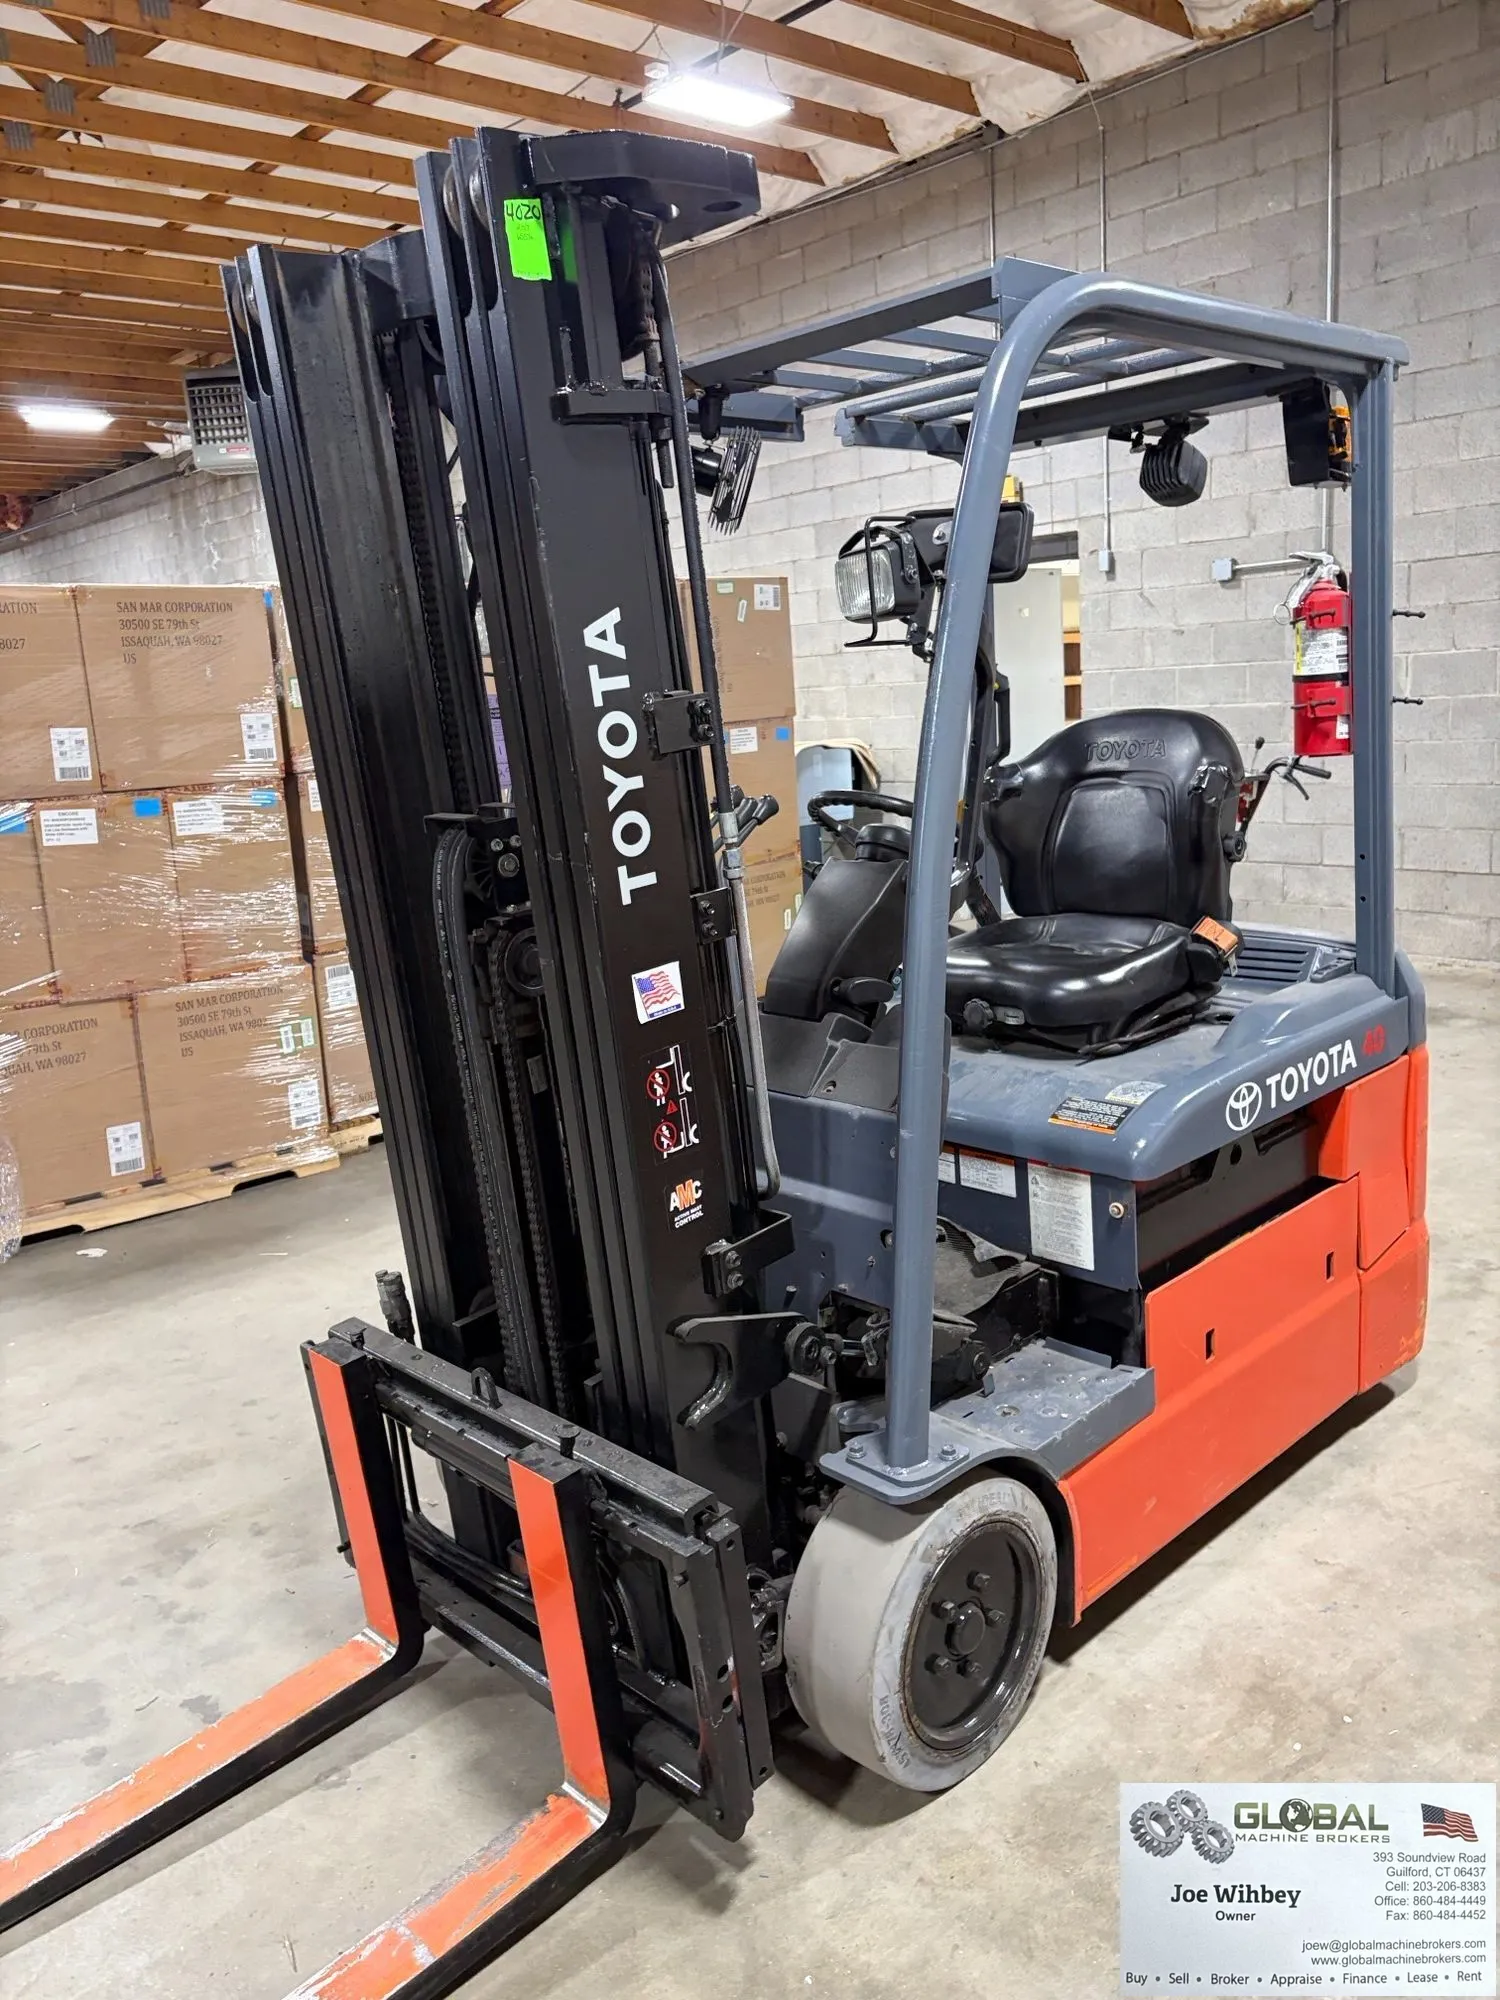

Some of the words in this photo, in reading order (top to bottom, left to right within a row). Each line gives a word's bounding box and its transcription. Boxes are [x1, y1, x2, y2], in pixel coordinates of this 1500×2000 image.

[506, 203, 541, 221] 4020
[116, 601, 137, 613] SAN
[139, 601, 162, 613] MAR
[164, 601, 233, 613] CORPORATION
[119, 619, 150, 630] 30500
[152, 619, 164, 630] SE
[166, 619, 188, 630] 79th
[121, 635, 174, 648] ISSAQUAH,
[175, 635, 191, 647] WA
[193, 635, 222, 646] 98027
[123, 653, 137, 664] US
[583, 606, 658, 906] TOYOTA
[1084, 739, 1167, 761] TOYOTA
[175, 1000, 194, 1012] SAN
[196, 995, 218, 1009] MAR
[220, 985, 283, 1005] CORPORATION
[177, 1013, 206, 1027] 30500
[208, 1011, 219, 1022] SE
[221, 1006, 241, 1020] 79th
[243, 1006, 252, 1016] St
[23, 1018, 98, 1040] CORPORATION
[180, 1024, 228, 1043] ISSAQUAH,
[228, 1022, 244, 1033] WA
[52, 1040, 62, 1051] St
[181, 1047, 193, 1057] US
[35, 1058, 54, 1071] WA
[55, 1050, 86, 1068] 98027
[1266, 1038, 1358, 1109] TOYOTA
[670, 1179, 703, 1212] AMC
[675, 1210, 704, 1228] CONTROL
